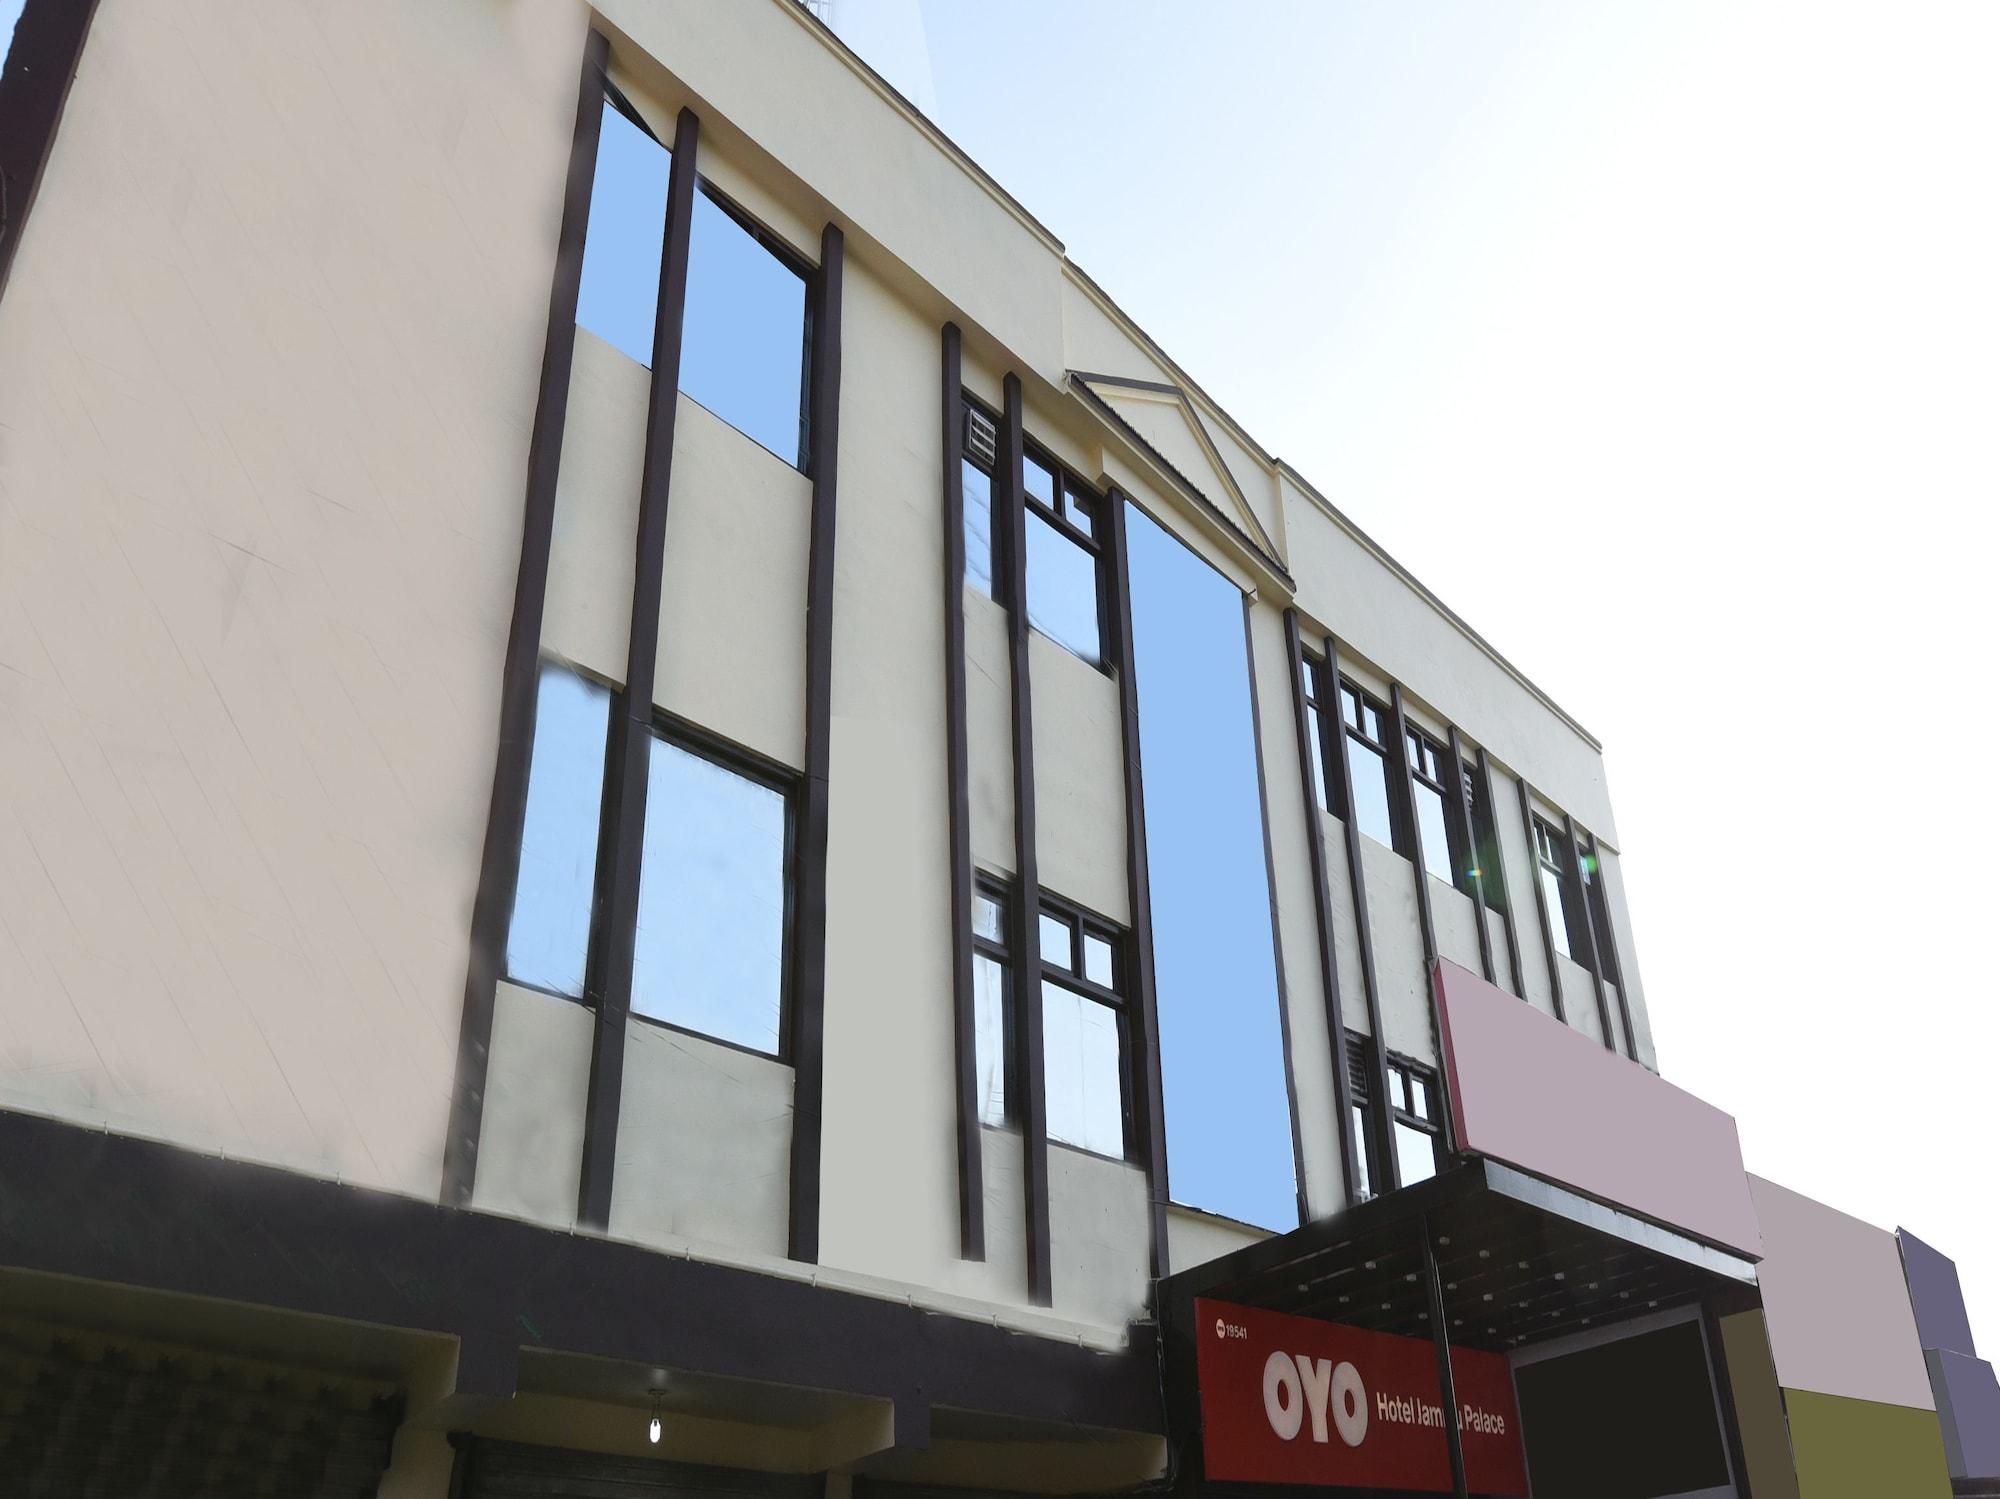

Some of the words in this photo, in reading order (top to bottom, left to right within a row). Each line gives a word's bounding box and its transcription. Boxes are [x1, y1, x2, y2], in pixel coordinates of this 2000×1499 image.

[1263, 1351, 1368, 1447] OYO
[1376, 1392, 1415, 1424] Hotel
[1416, 1397, 1463, 1430] Jamu
[1464, 1404, 1505, 1435] Palace
